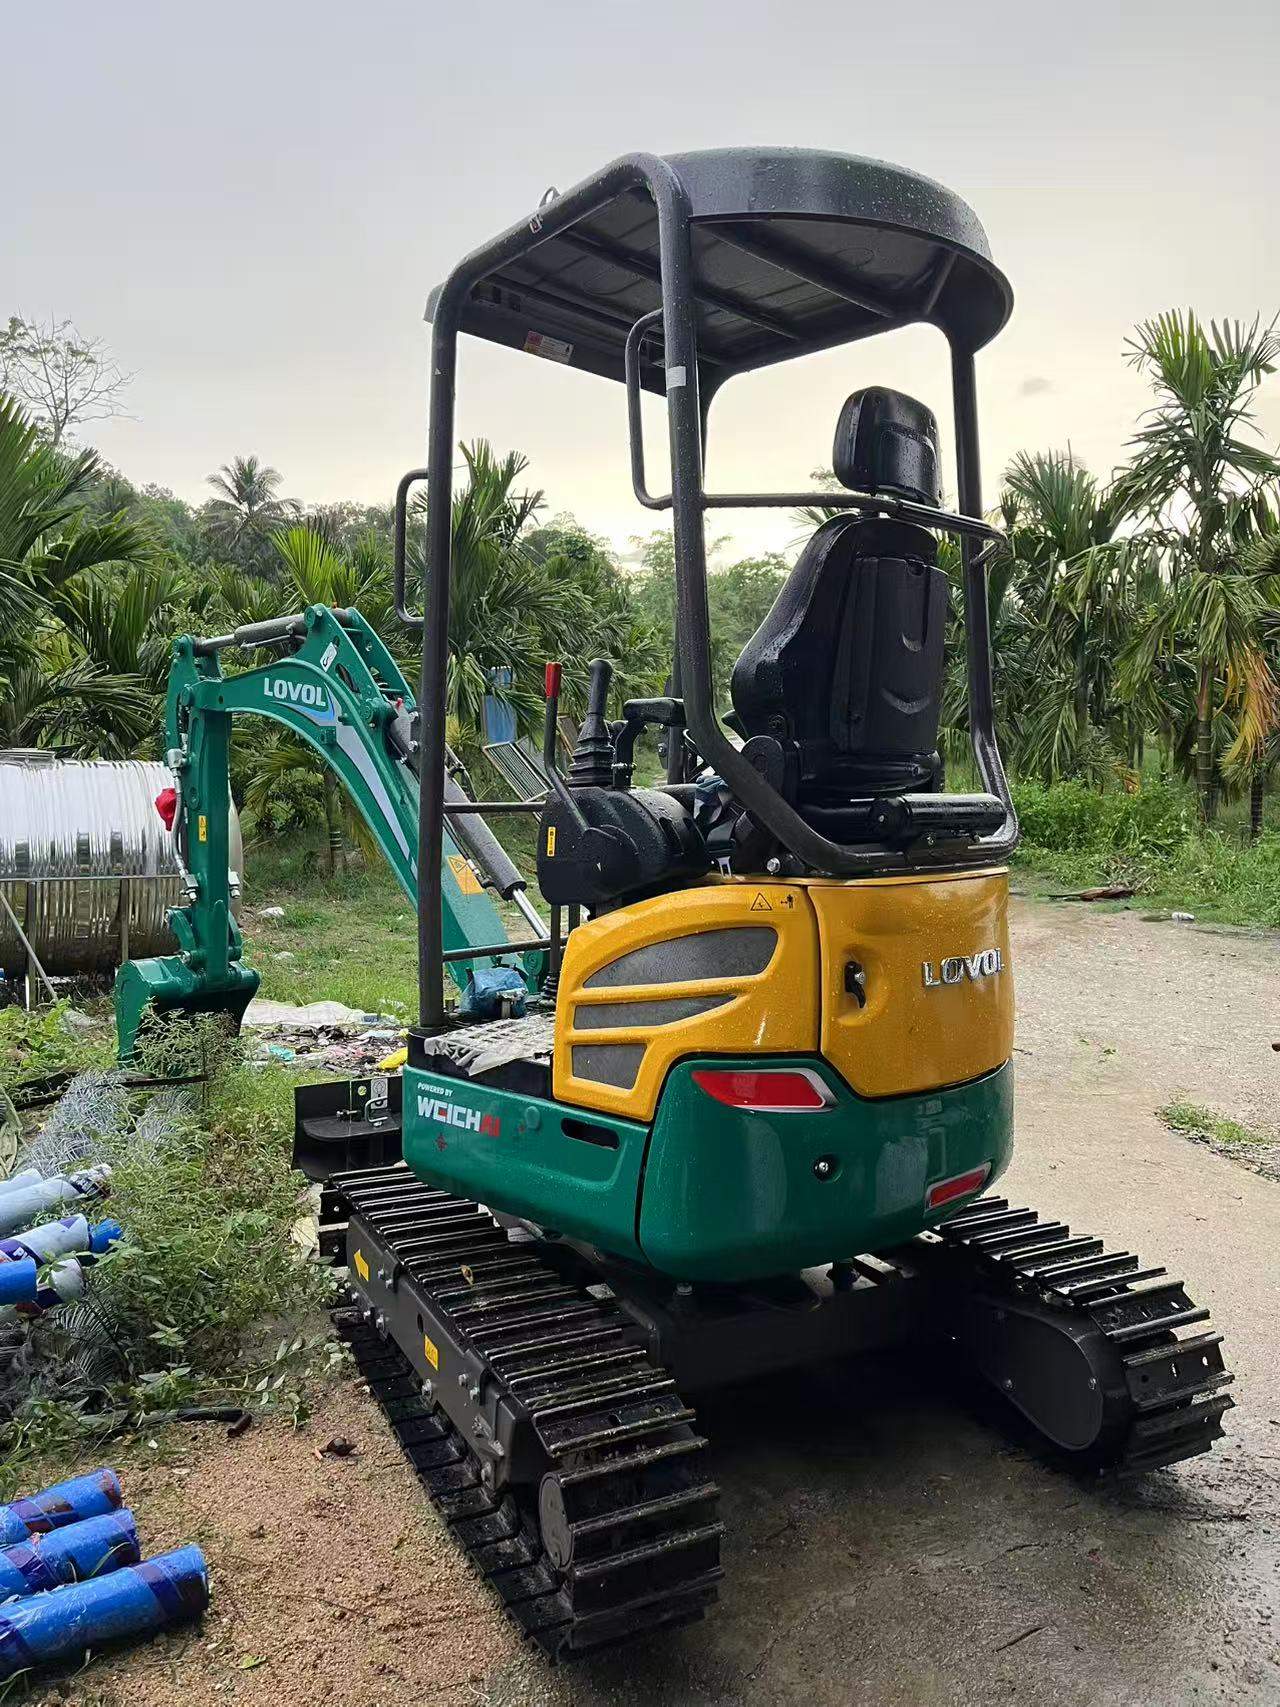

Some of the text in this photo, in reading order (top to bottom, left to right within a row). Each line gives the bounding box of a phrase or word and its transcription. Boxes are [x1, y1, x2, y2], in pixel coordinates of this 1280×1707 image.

[263, 677, 327, 707] LOVOL
[417, 1082, 454, 1097] POWERED BY
[417, 1095, 500, 1137] WEICHAI
